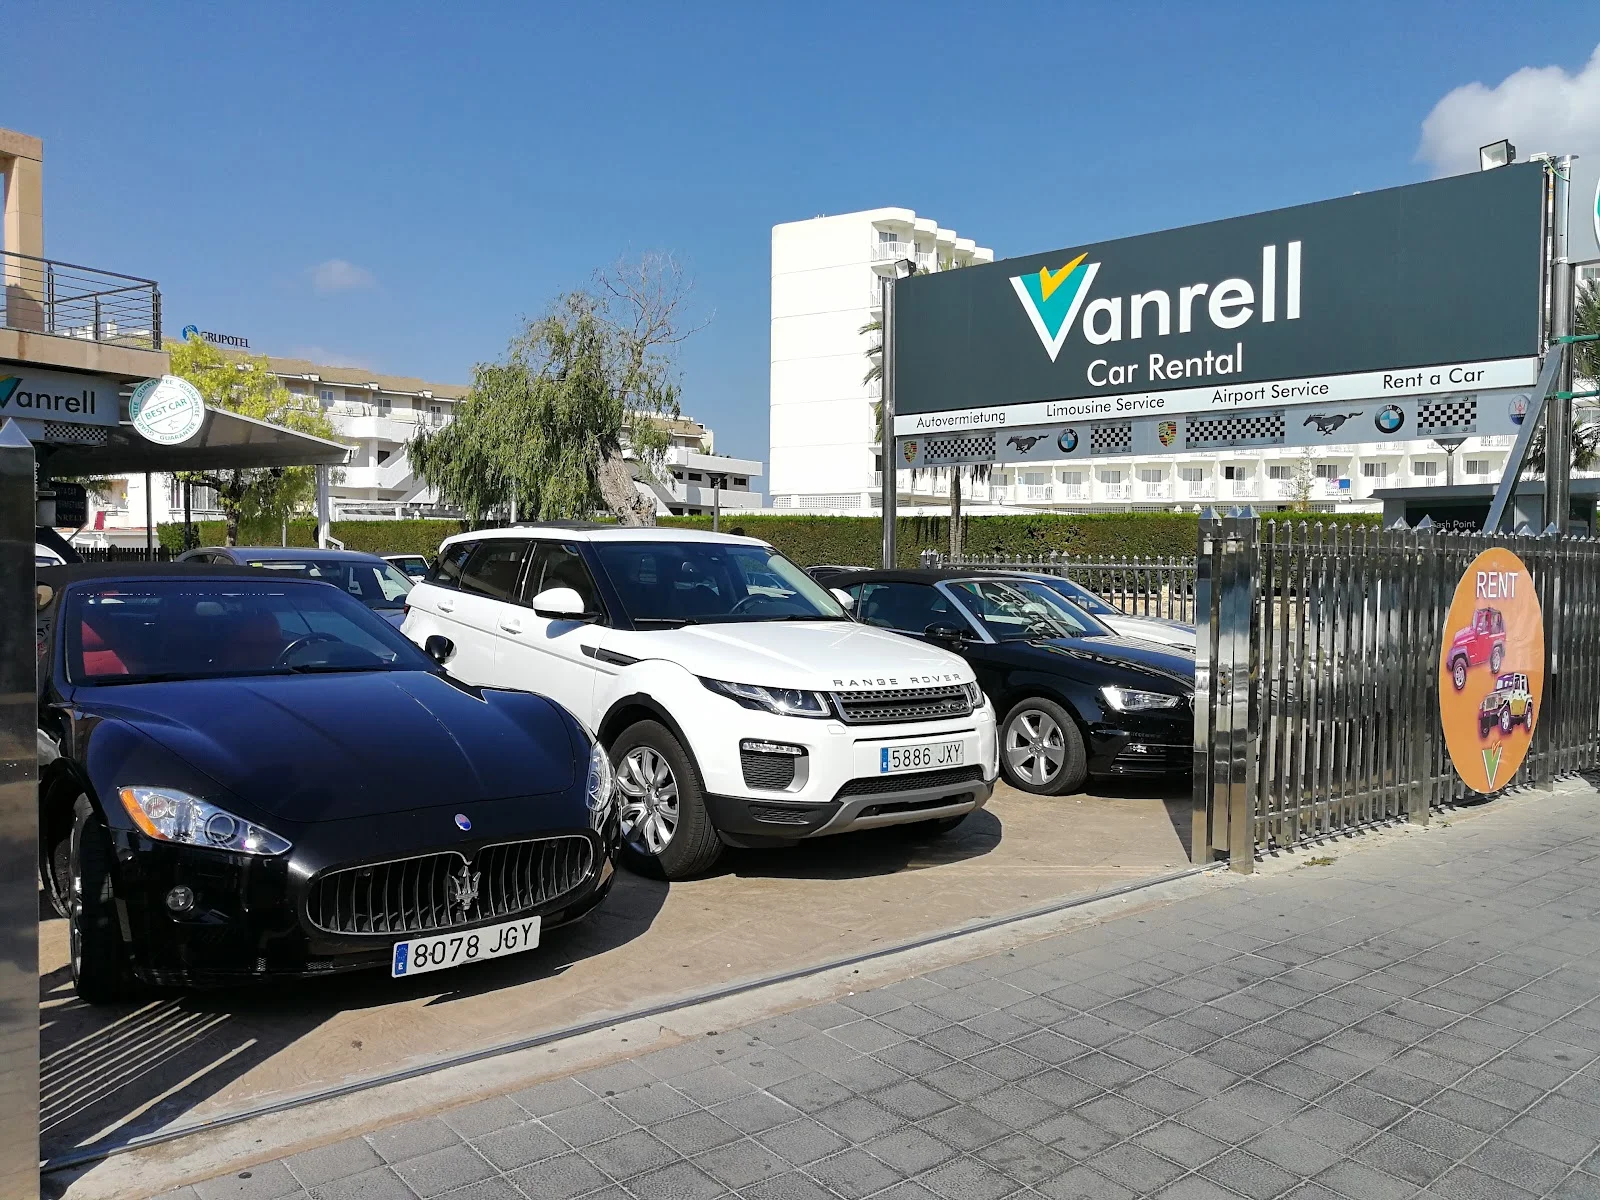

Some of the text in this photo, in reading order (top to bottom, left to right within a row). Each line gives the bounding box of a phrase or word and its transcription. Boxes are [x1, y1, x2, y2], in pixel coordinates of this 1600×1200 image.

[1009, 241, 1302, 363] Vanrell
[200, 331, 251, 348] GRUPOTEL
[1087, 343, 1243, 387] Car Rental
[1383, 367, 1485, 389] Rent a Car
[1212, 382, 1329, 406] Airport Service
[144, 398, 188, 420] BEST CAR
[1046, 396, 1165, 417] Limousine Service
[916, 410, 1006, 428] Autovermietung
[1453, 520, 1476, 529] Point
[1476, 571, 1518, 598] RENT
[833, 673, 961, 687] RANGE ROVER
[892, 747, 931, 768] 5886
[937, 743, 961, 764] JXY
[398, 922, 534, 970] E 8078 JGY
